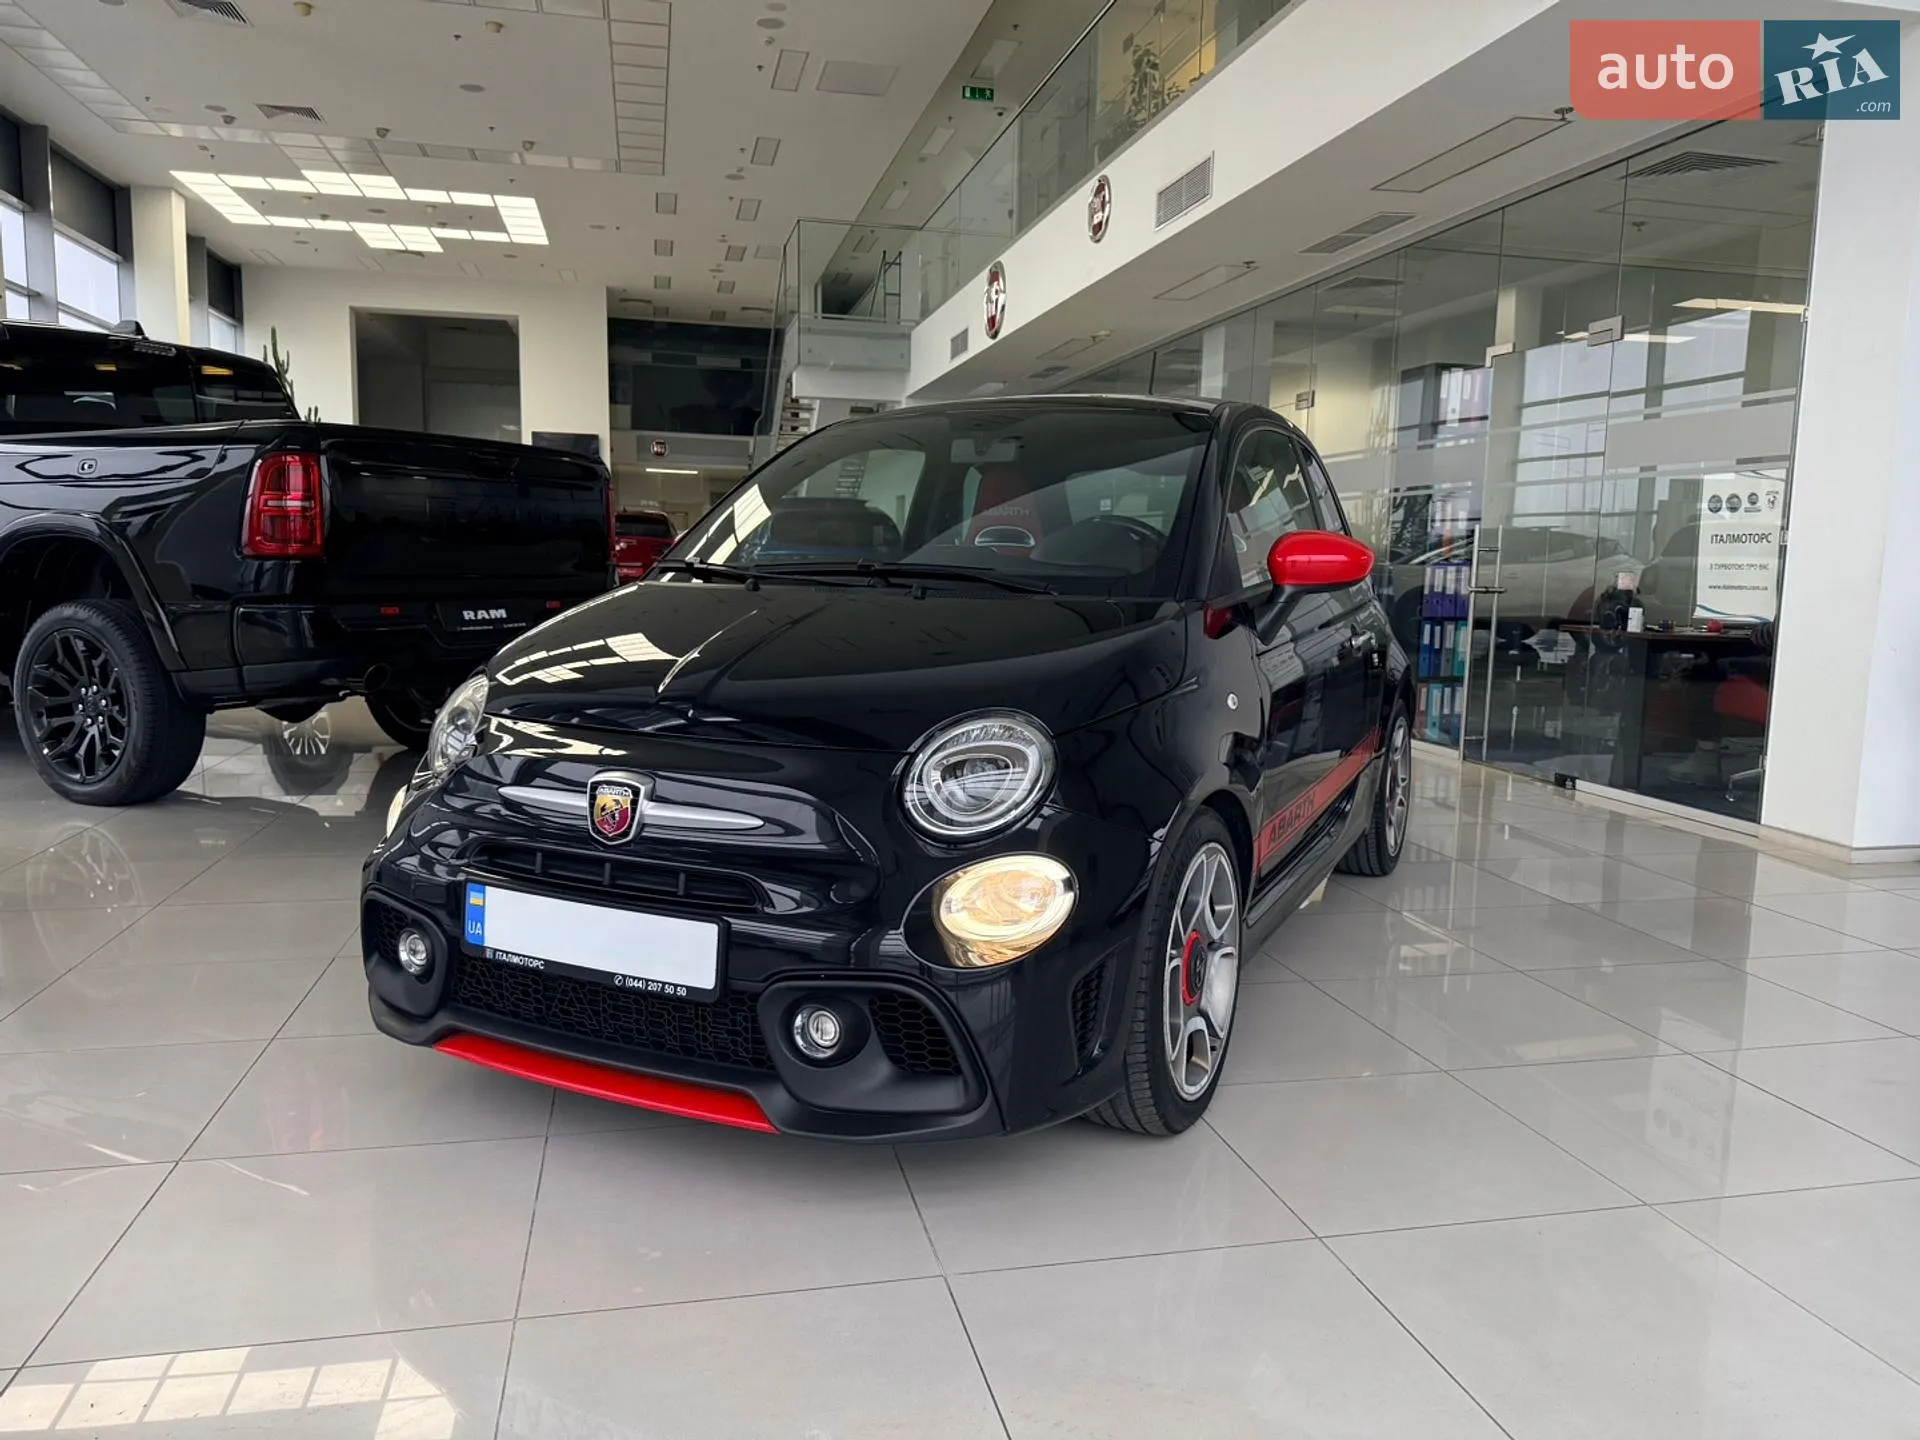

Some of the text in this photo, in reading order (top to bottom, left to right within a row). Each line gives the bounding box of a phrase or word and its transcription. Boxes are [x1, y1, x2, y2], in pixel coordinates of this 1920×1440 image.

[1710, 532, 1772, 545] ІТАЛМОТОРС
[462, 608, 507, 620] RAM
[467, 920, 482, 935] UA
[495, 951, 545, 970] ІТАЛМОТОРС
[625, 977, 687, 997] (044) 207 50 50
